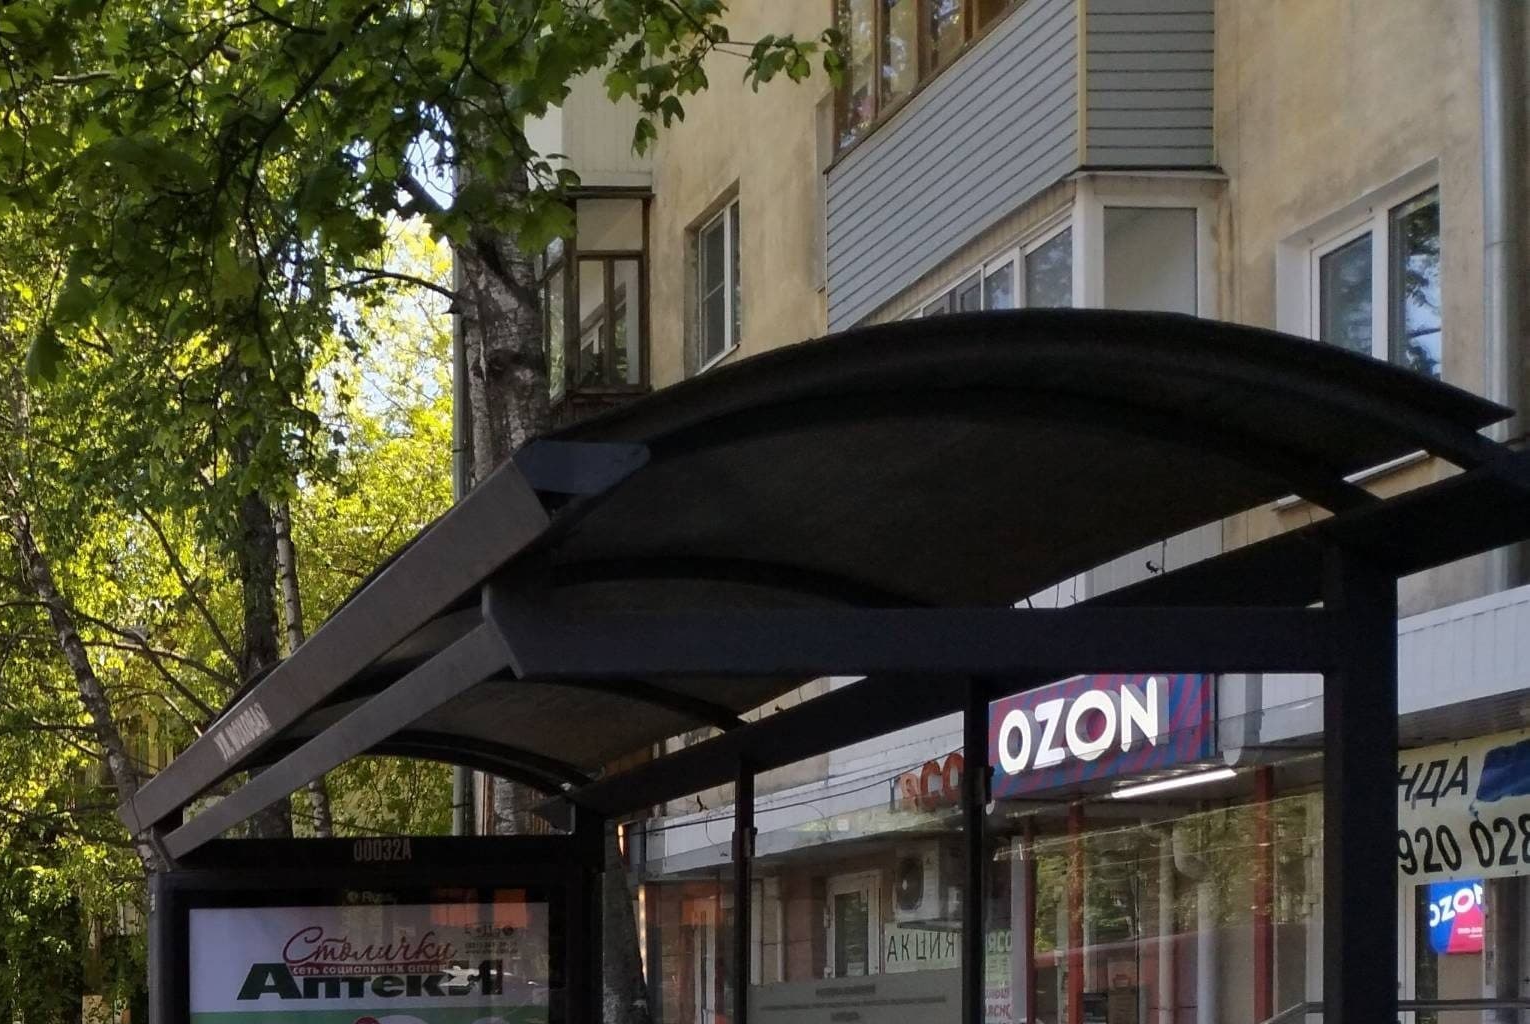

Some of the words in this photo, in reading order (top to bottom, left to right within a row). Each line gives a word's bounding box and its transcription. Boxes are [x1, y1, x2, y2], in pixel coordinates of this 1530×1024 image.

[998, 677, 1160, 775] OZON
[1398, 824, 1463, 876] 920
[282, 926, 455, 964] Столички
[886, 932, 955, 963] АКЦИЯ
[293, 965, 320, 976] сеть
